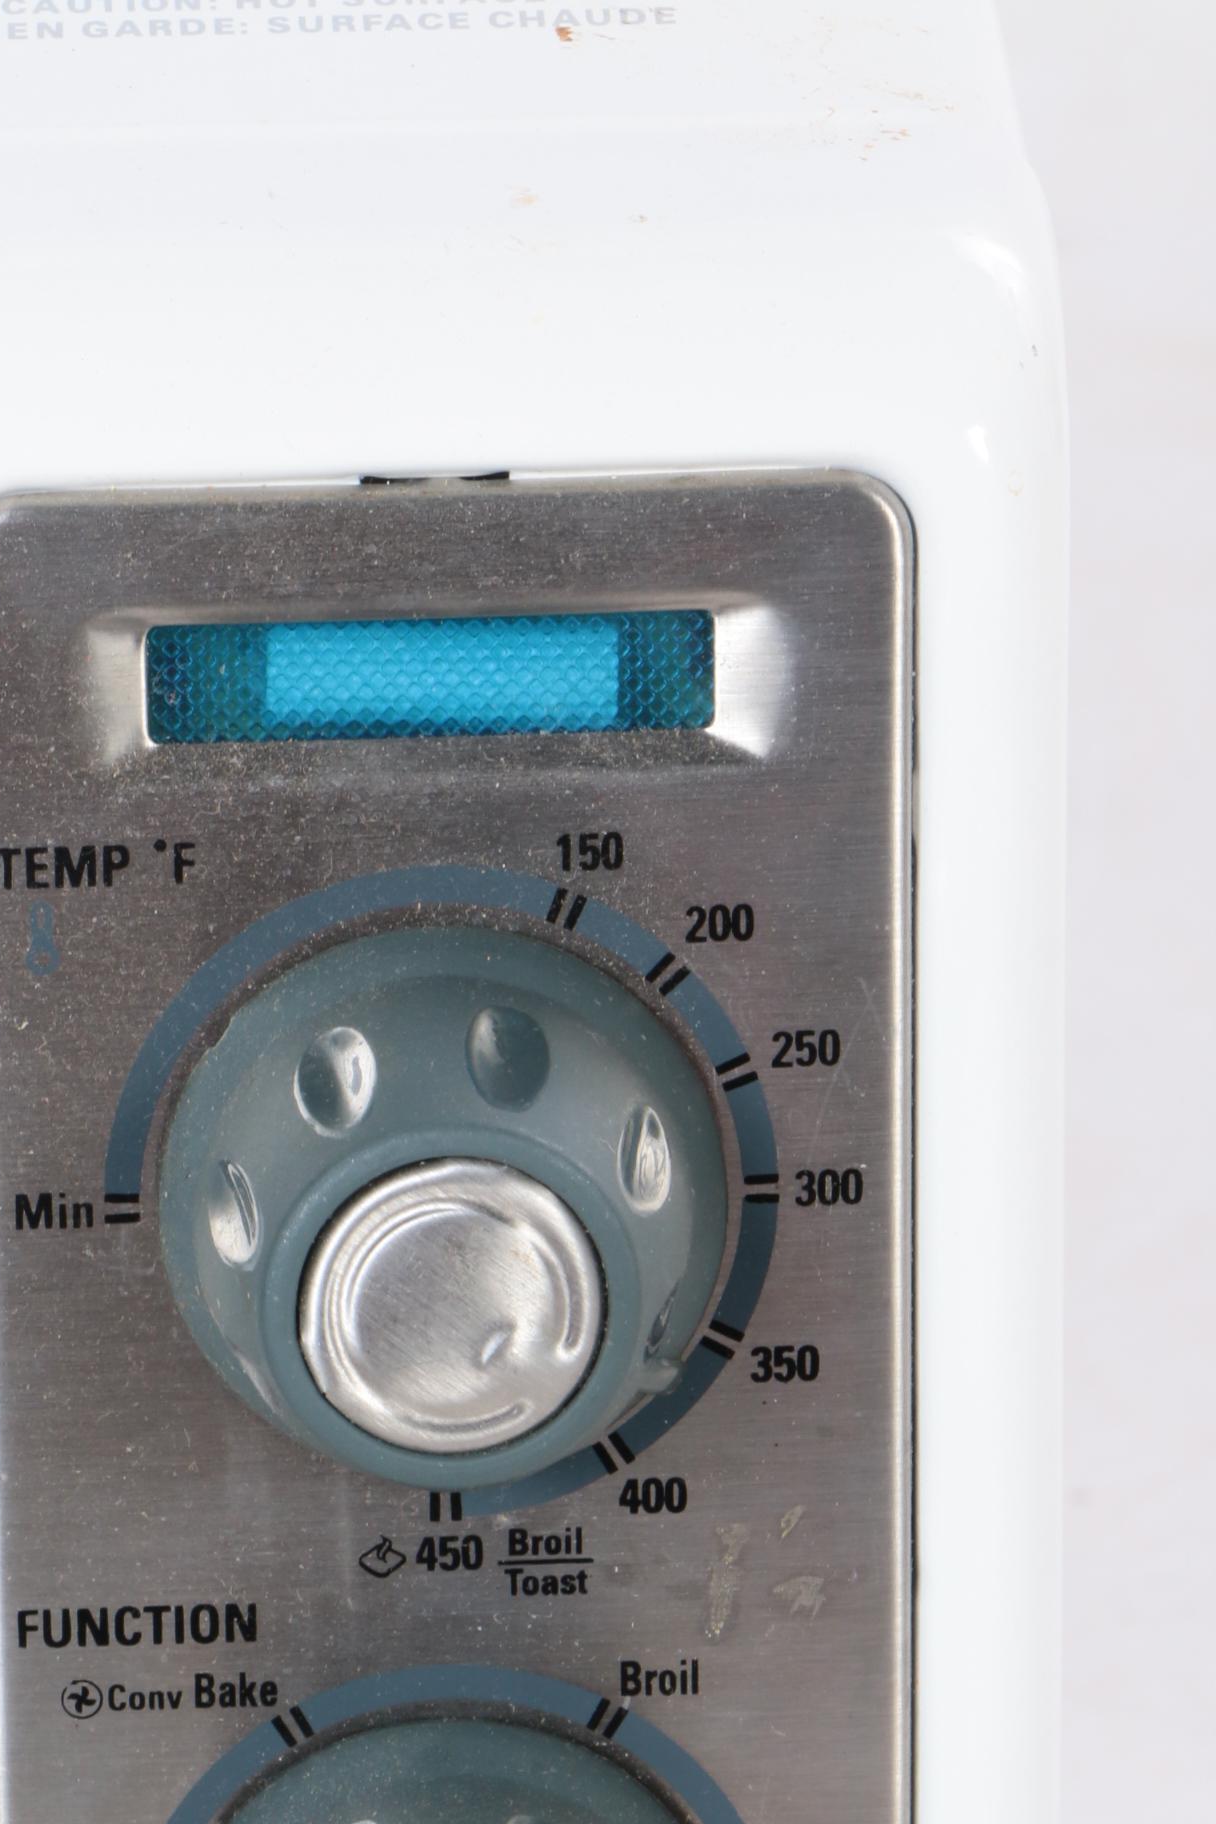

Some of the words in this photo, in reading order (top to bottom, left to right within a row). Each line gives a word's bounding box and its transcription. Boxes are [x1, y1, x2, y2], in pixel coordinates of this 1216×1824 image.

[8, 22, 63, 40] EN
[82, 18, 247, 38] GARDE:
[268, 12, 469, 34] SURFACE
[489, 7, 675, 28] CHAUDE
[557, 832, 623, 871] 150
[686, 904, 754, 943] 200
[772, 1030, 840, 1068] 250
[795, 1169, 863, 1207] 300
[16, 1193, 93, 1230] Min
[751, 1345, 819, 1383] 350
[619, 1477, 687, 1514] 400
[416, 1535, 483, 1571] 450
[509, 1526, 583, 1556] Broil
[504, 1568, 587, 1596] Toast
[18, 1603, 257, 1648] FUNCTION
[108, 1684, 182, 1711] Conv
[195, 1672, 278, 1708] Bake
[620, 1660, 698, 1696] Broil
